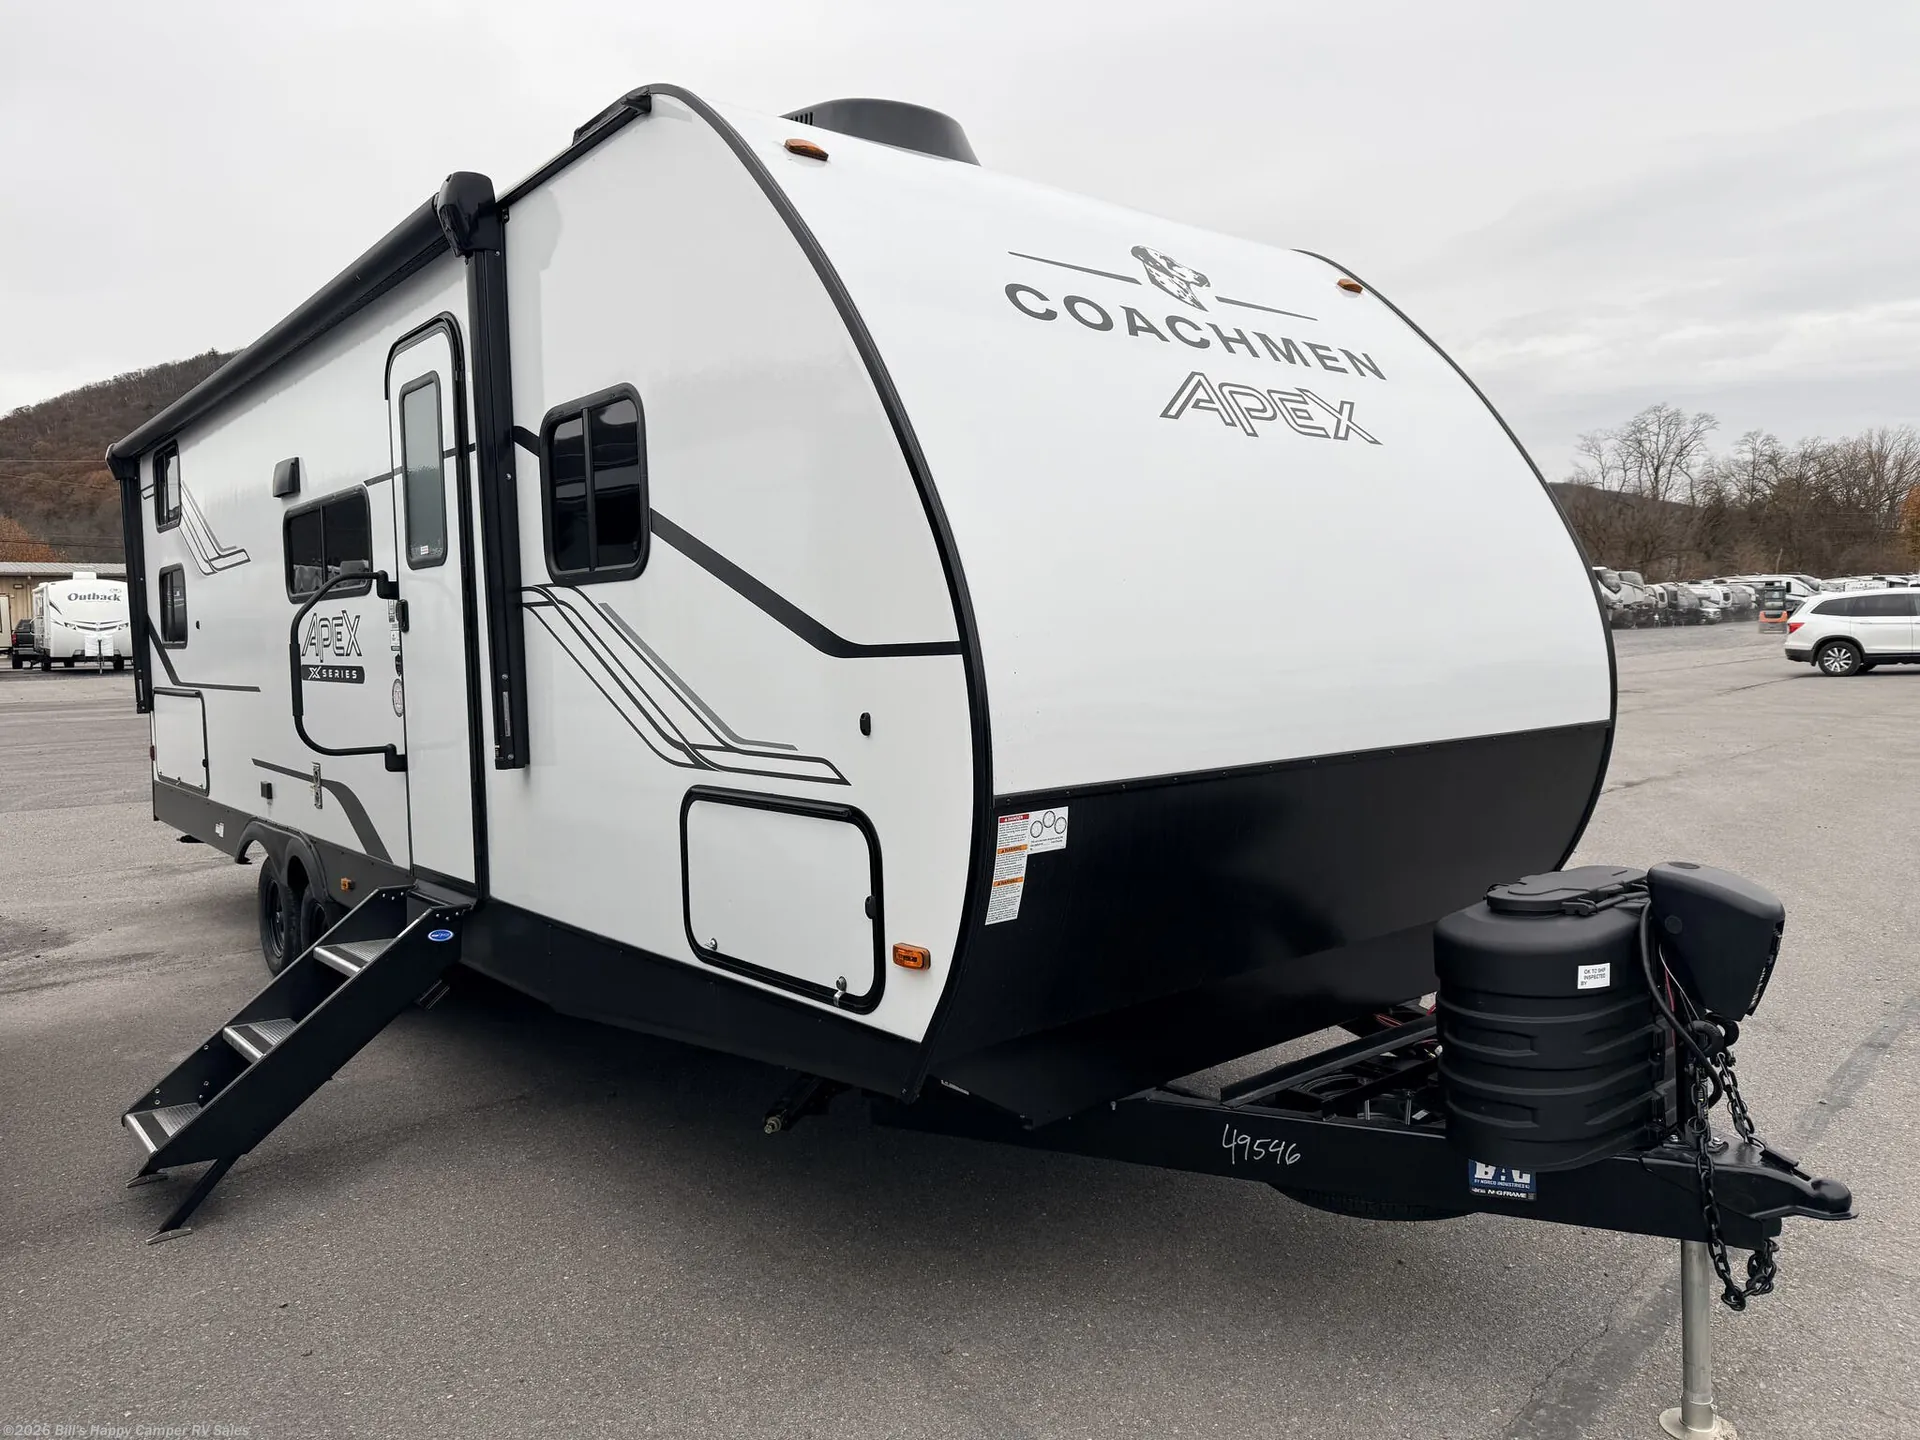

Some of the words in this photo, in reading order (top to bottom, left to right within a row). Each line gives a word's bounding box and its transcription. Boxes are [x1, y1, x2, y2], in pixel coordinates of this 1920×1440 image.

[1005, 283, 1387, 381] COACHMEN
[1159, 371, 1383, 445] APEX
[67, 592, 121, 602] Outback
[301, 610, 362, 663] APEX
[322, 669, 357, 679] SERIES
